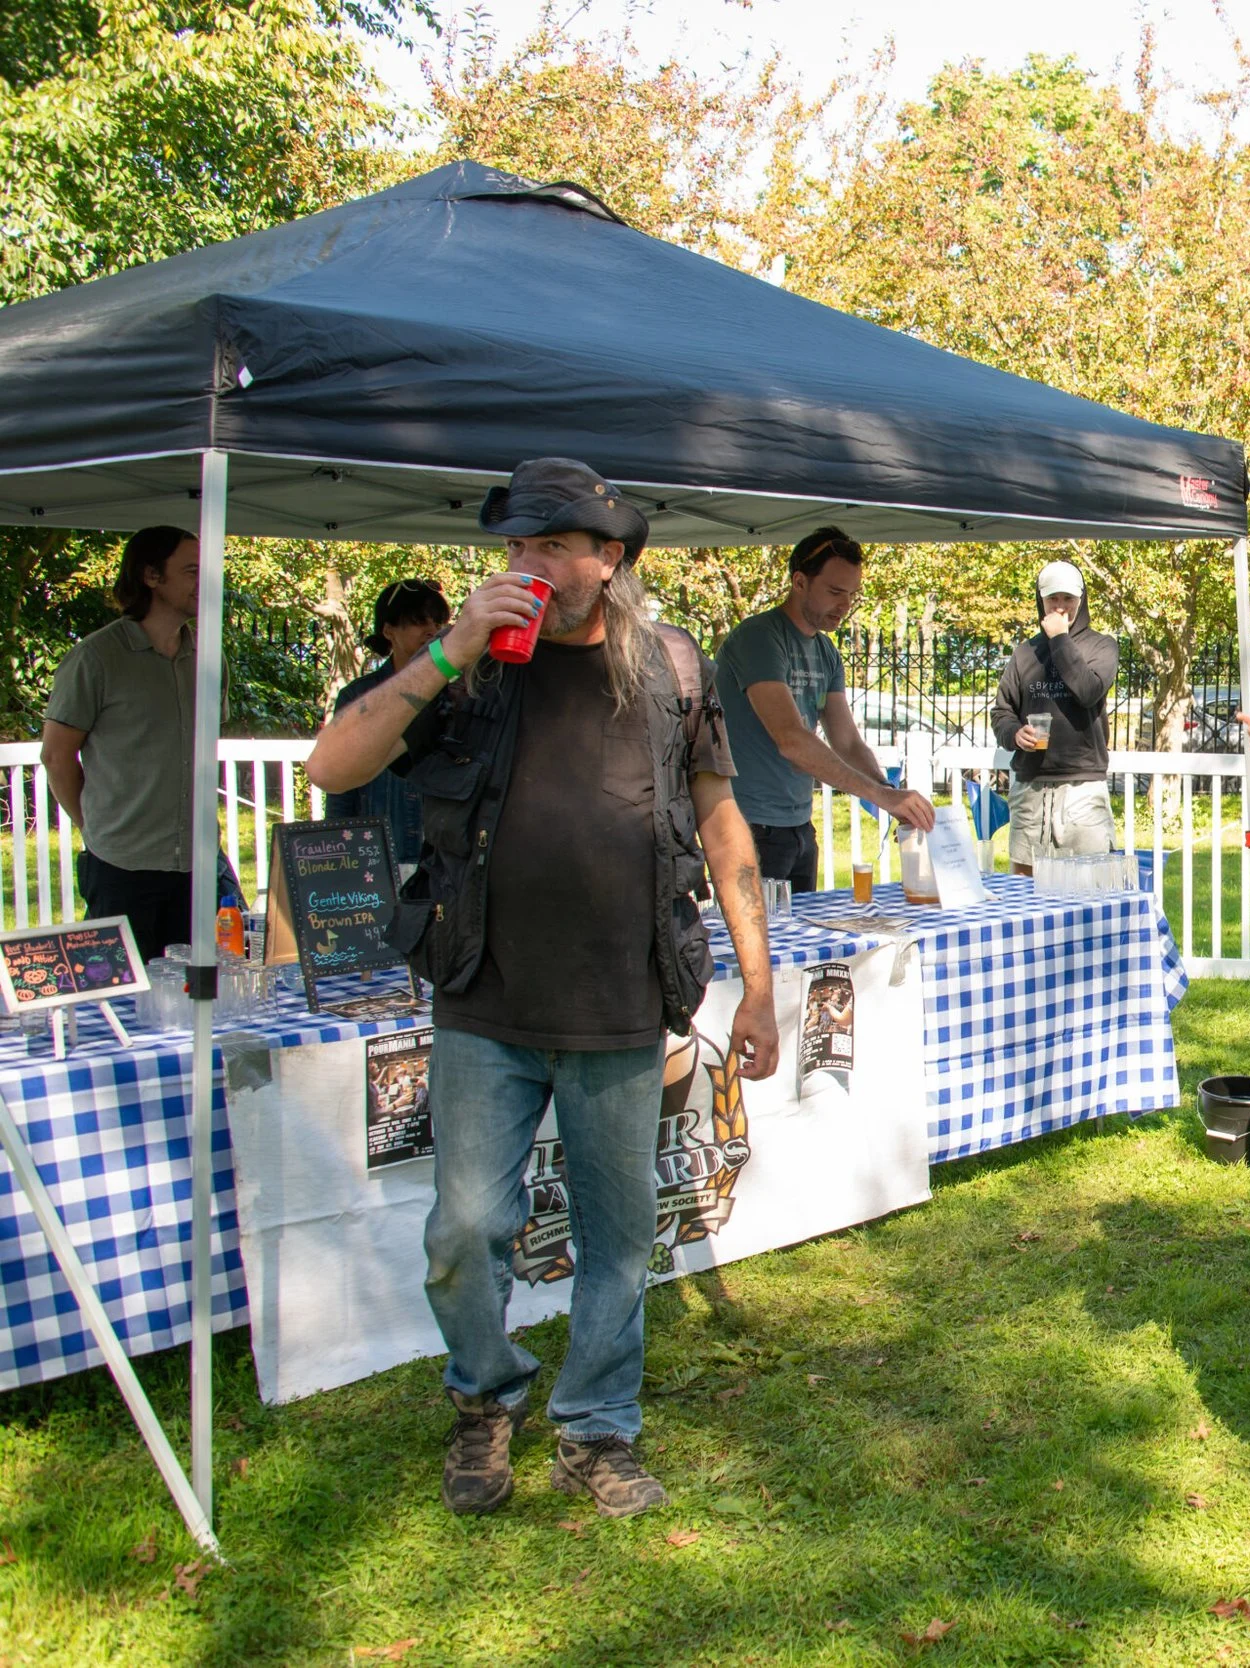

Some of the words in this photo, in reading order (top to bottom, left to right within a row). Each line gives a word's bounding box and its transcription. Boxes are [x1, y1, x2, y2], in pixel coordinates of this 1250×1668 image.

[298, 859, 337, 876] Blonde
[339, 856, 360, 869] Ale
[308, 891, 346, 908] Gentle
[347, 891, 380, 908] Viking
[308, 913, 352, 930] Brown
[354, 912, 375, 925] IPA
[671, 1193, 711, 1207] SOCIETY
[529, 1224, 571, 1246] RICHMO
